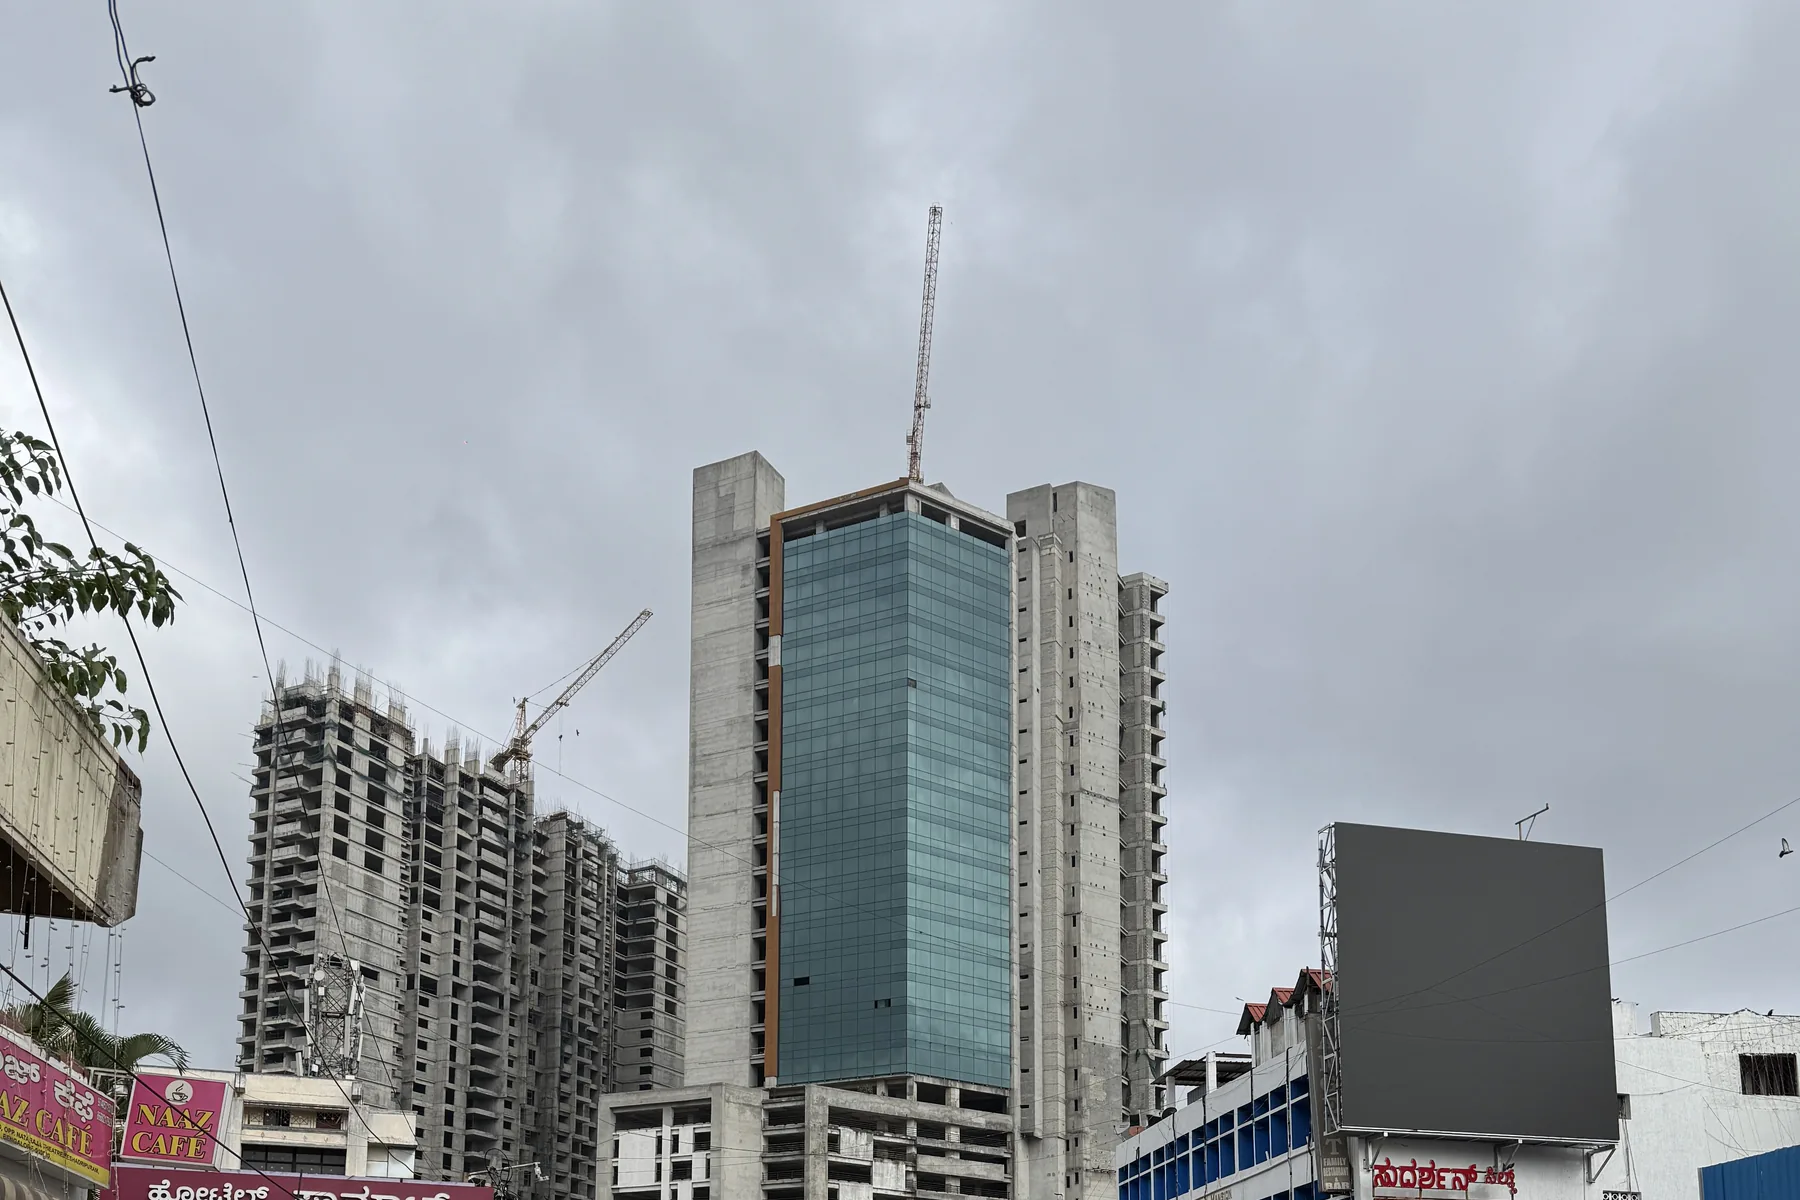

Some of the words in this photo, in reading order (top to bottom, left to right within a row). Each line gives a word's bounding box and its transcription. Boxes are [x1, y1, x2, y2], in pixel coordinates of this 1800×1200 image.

[35, 1107, 94, 1159] CAFÉ
[135, 1103, 214, 1132] NAAZ
[132, 1131, 207, 1159] CAFÉ
[1373, 1157, 1478, 1191] ಸುದರ್ಶನ್
